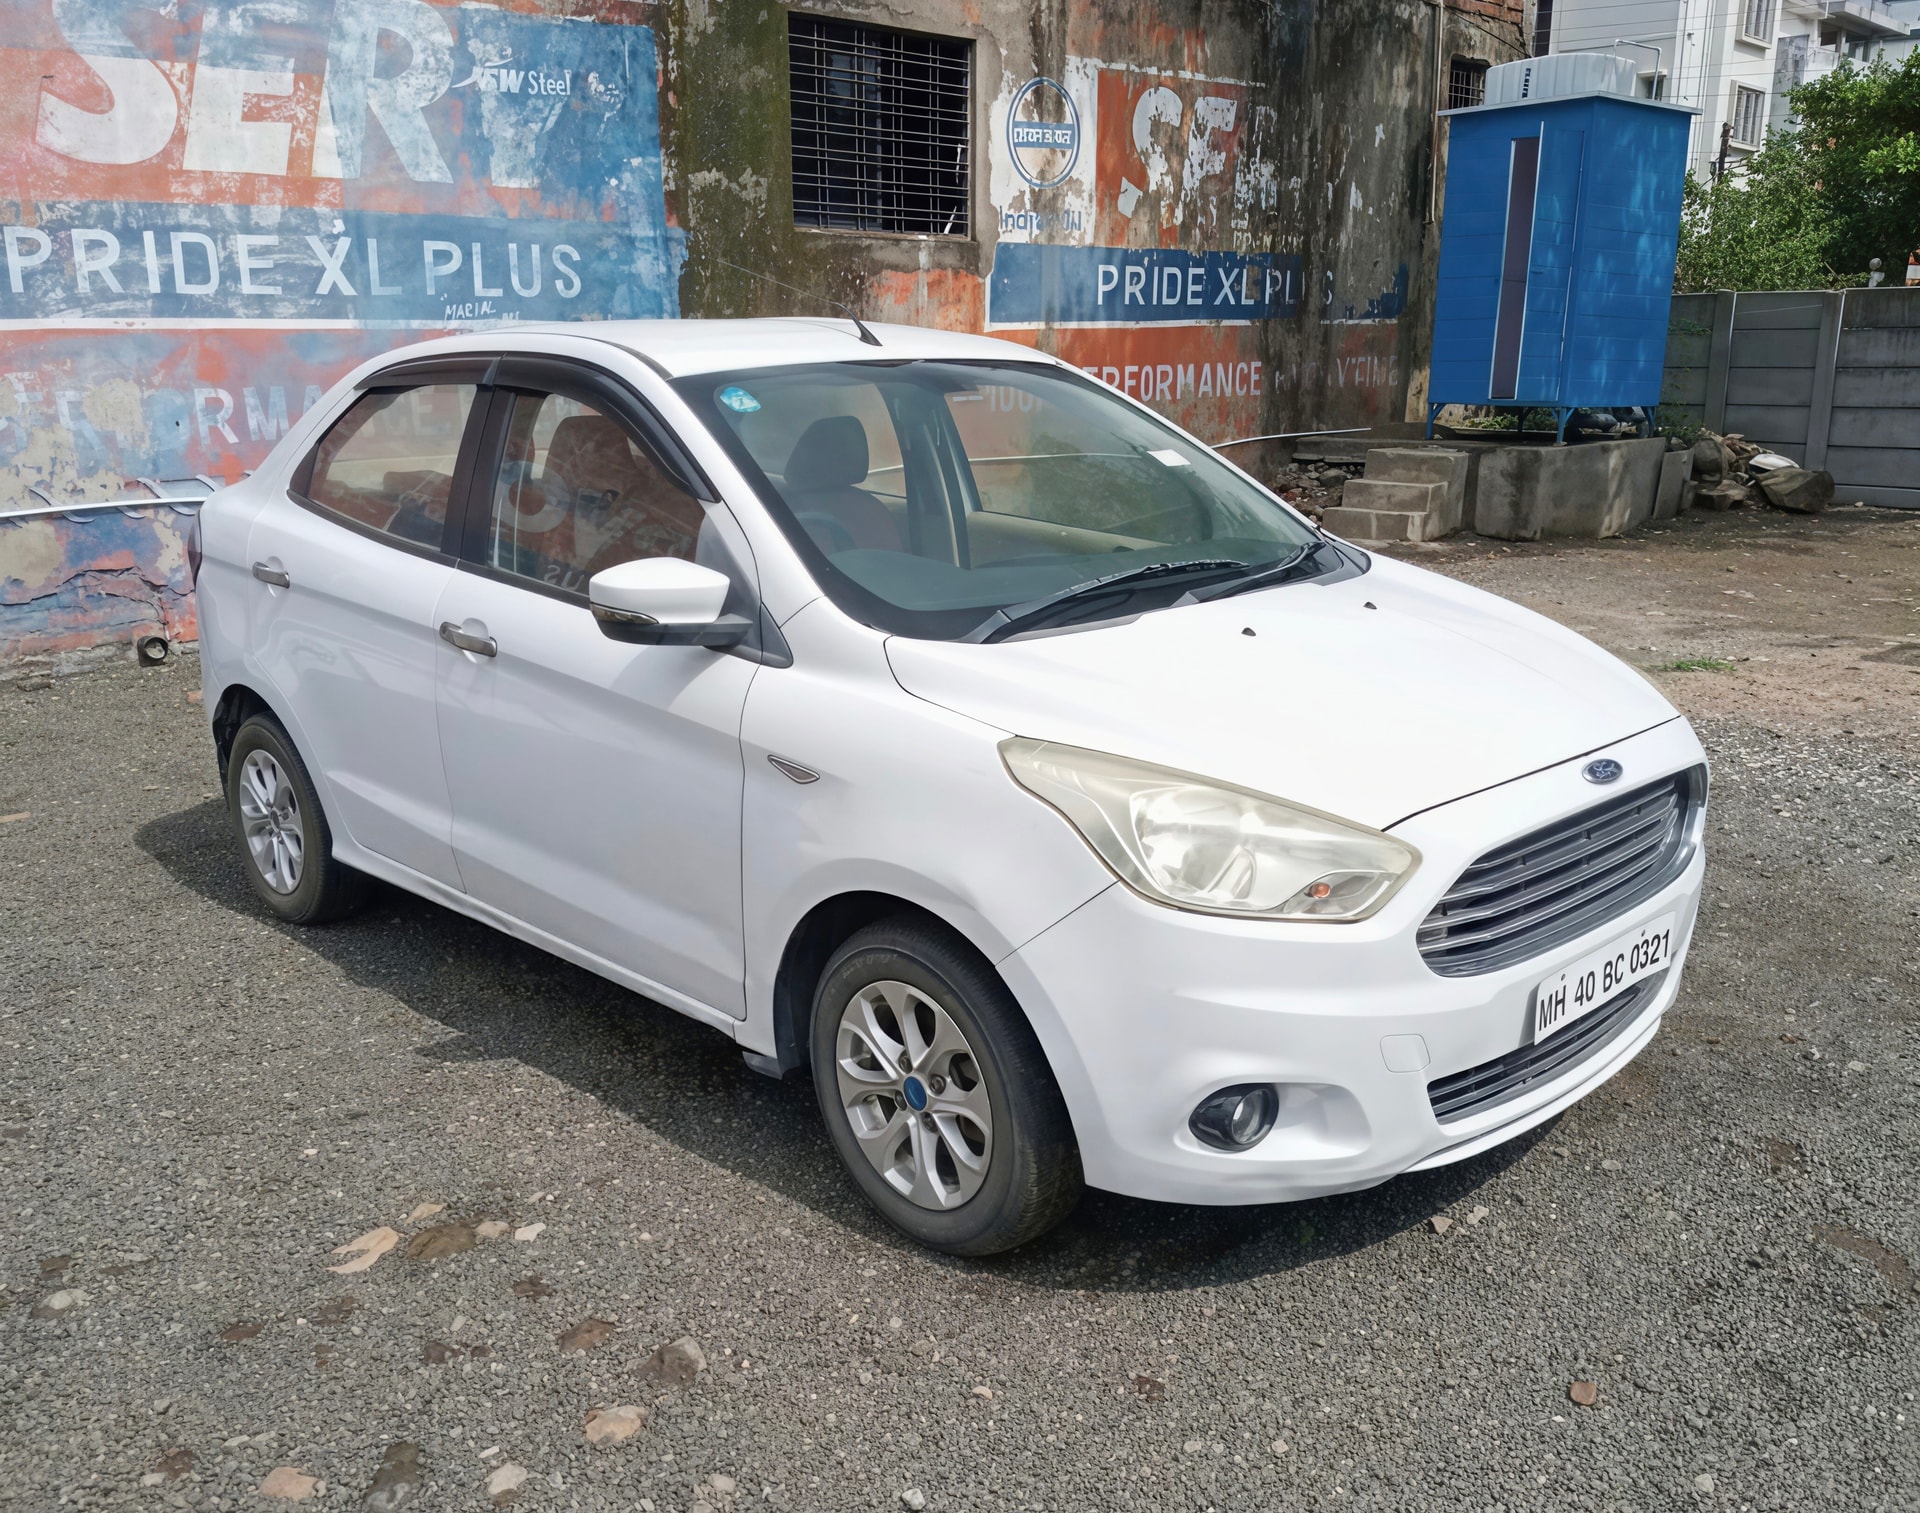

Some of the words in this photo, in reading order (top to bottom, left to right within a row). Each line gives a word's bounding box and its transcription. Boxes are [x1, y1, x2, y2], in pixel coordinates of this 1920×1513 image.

[528, 69, 572, 96] Steel
[3, 226, 283, 297] PRIDE
[305, 236, 402, 297] XL
[423, 240, 582, 299] PLUS
[1097, 265, 1205, 306] PRIDE
[1213, 267, 1255, 306] XL
[1538, 984, 1567, 1032] MH
[1574, 970, 1596, 1007] 40
[1603, 953, 1625, 994] BC
[1630, 928, 1670, 975] 0321
